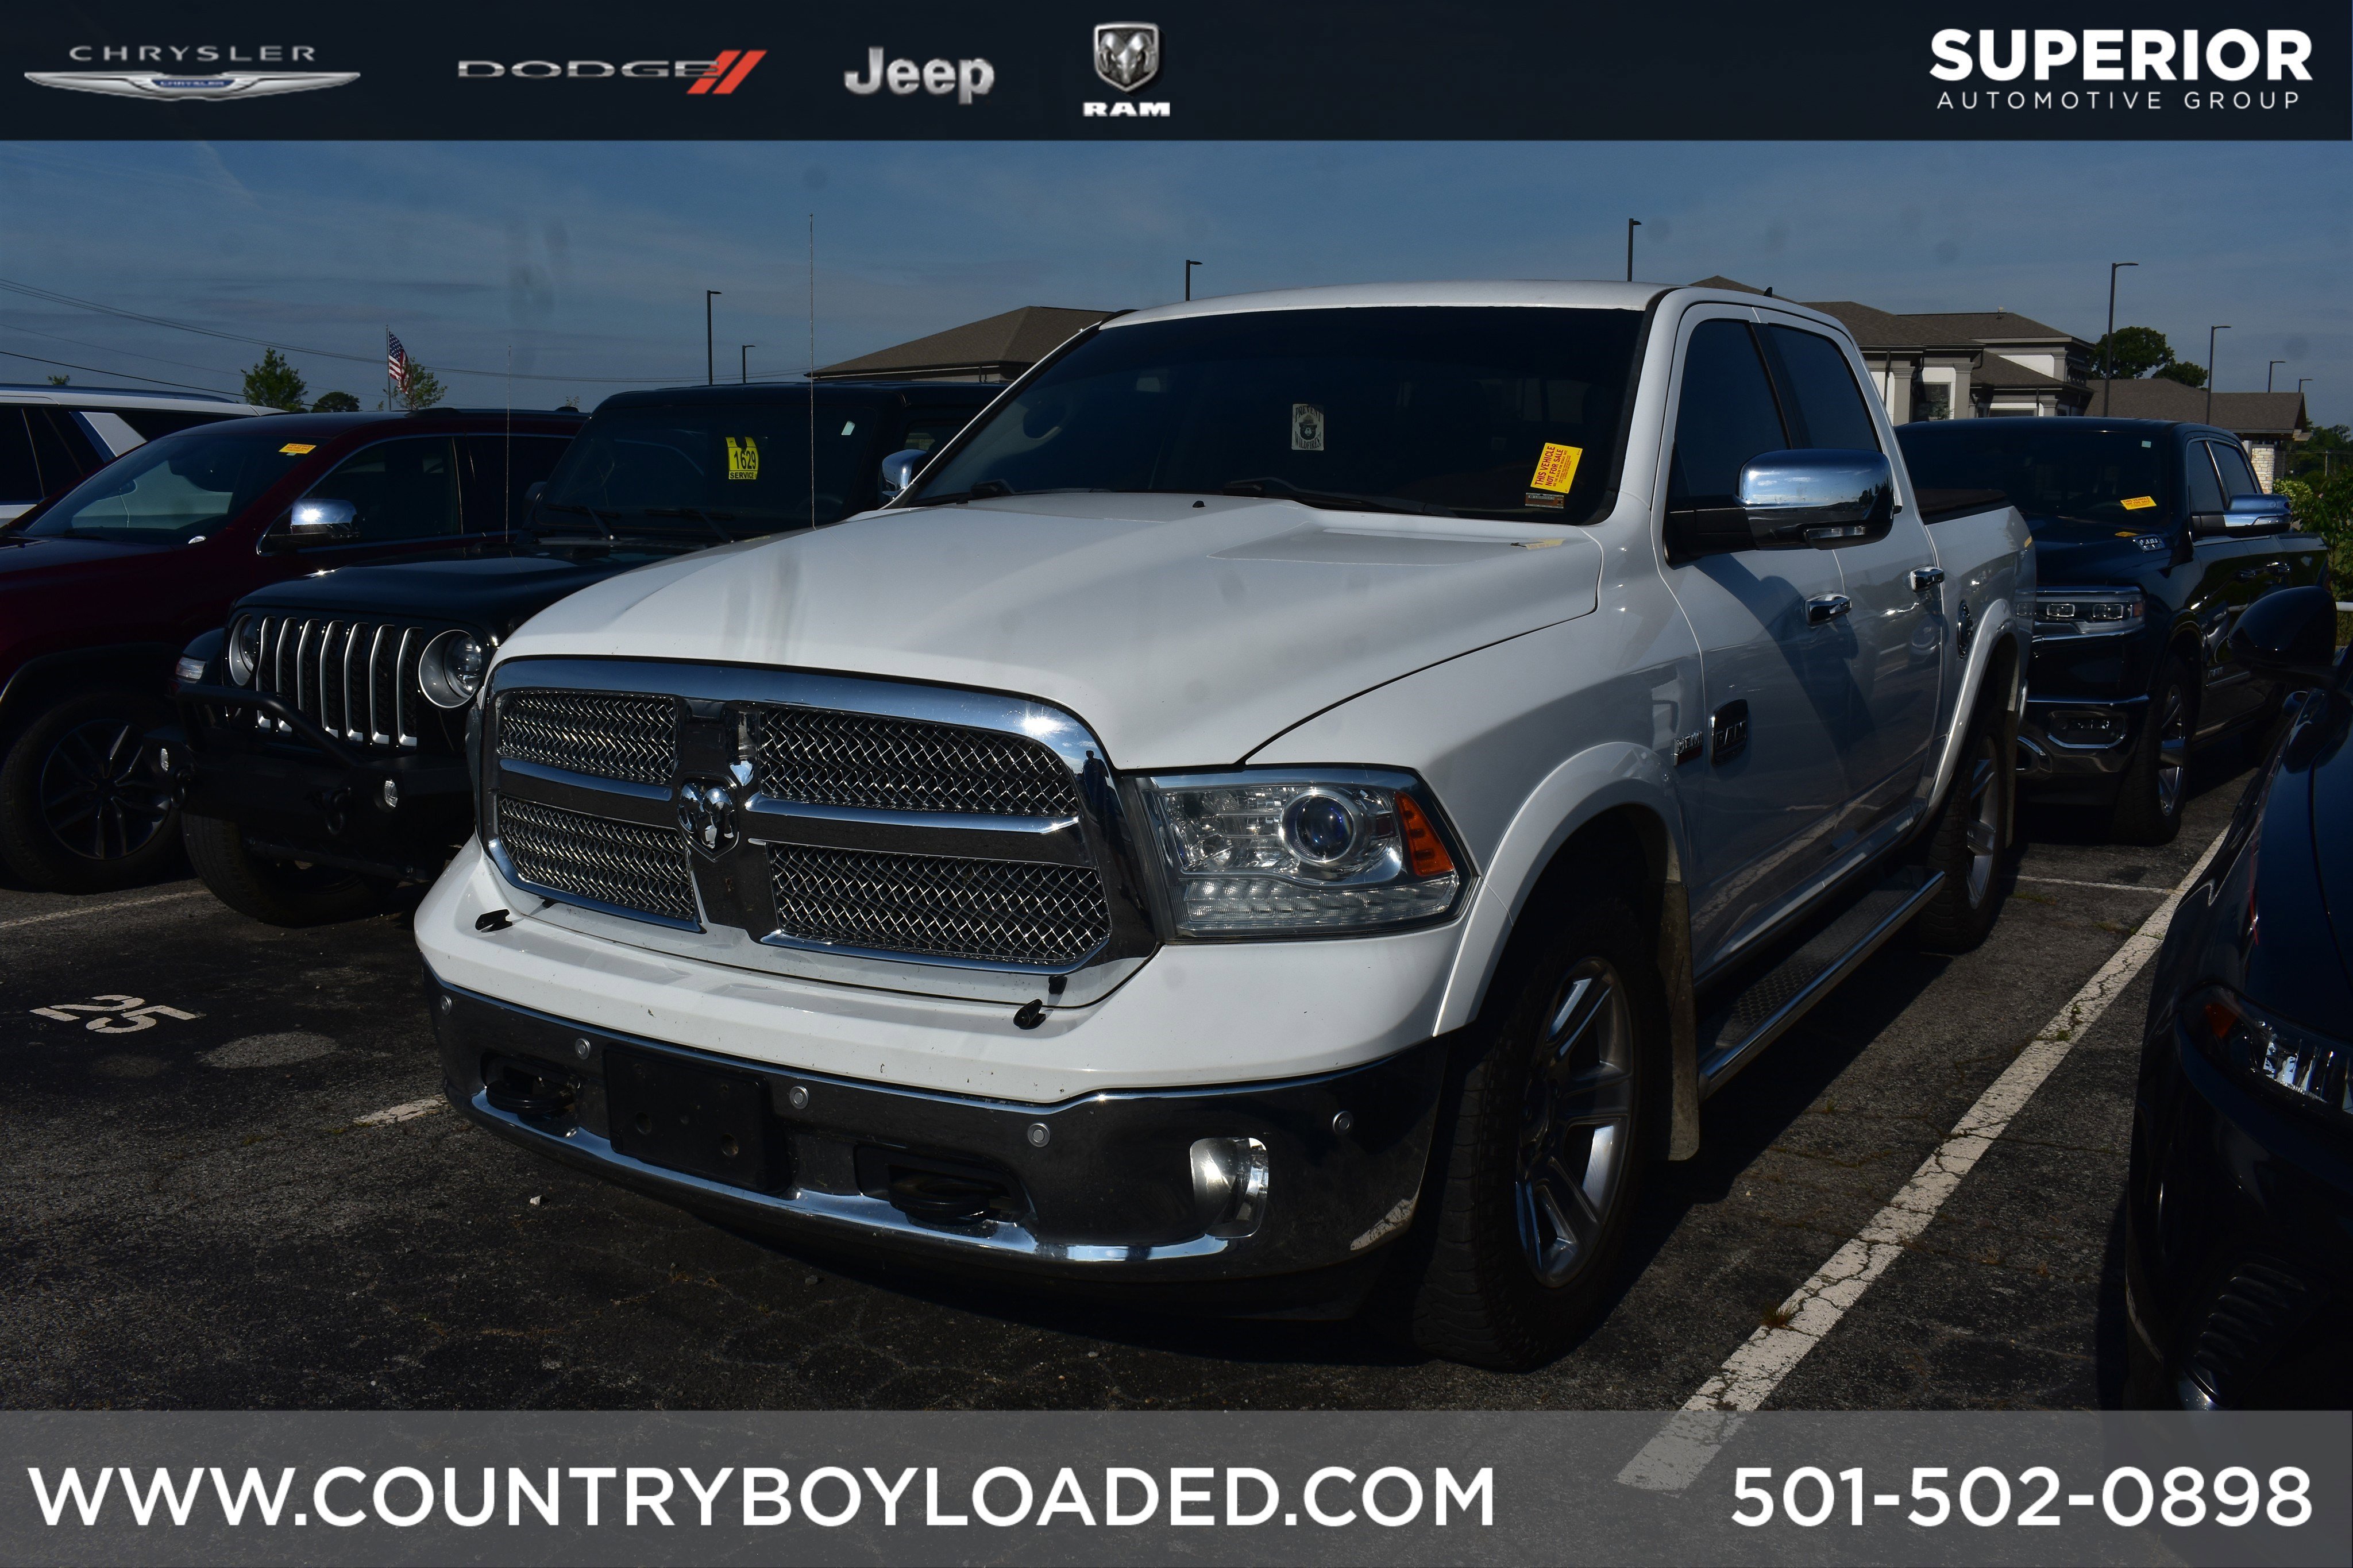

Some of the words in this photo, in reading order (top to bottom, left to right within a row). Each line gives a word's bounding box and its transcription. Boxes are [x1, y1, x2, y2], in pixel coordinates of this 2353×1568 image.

[1295, 431, 1321, 449] WILDFIRES
[734, 450, 756, 469] 1629
[1553, 449, 1564, 462] SALE
[1534, 471, 1546, 485] THIS
[1540, 446, 1556, 470] VEHICLE
[1549, 463, 1559, 474] FOR
[1545, 475, 1554, 486] NOT
[29, 994, 198, 1033] 25
